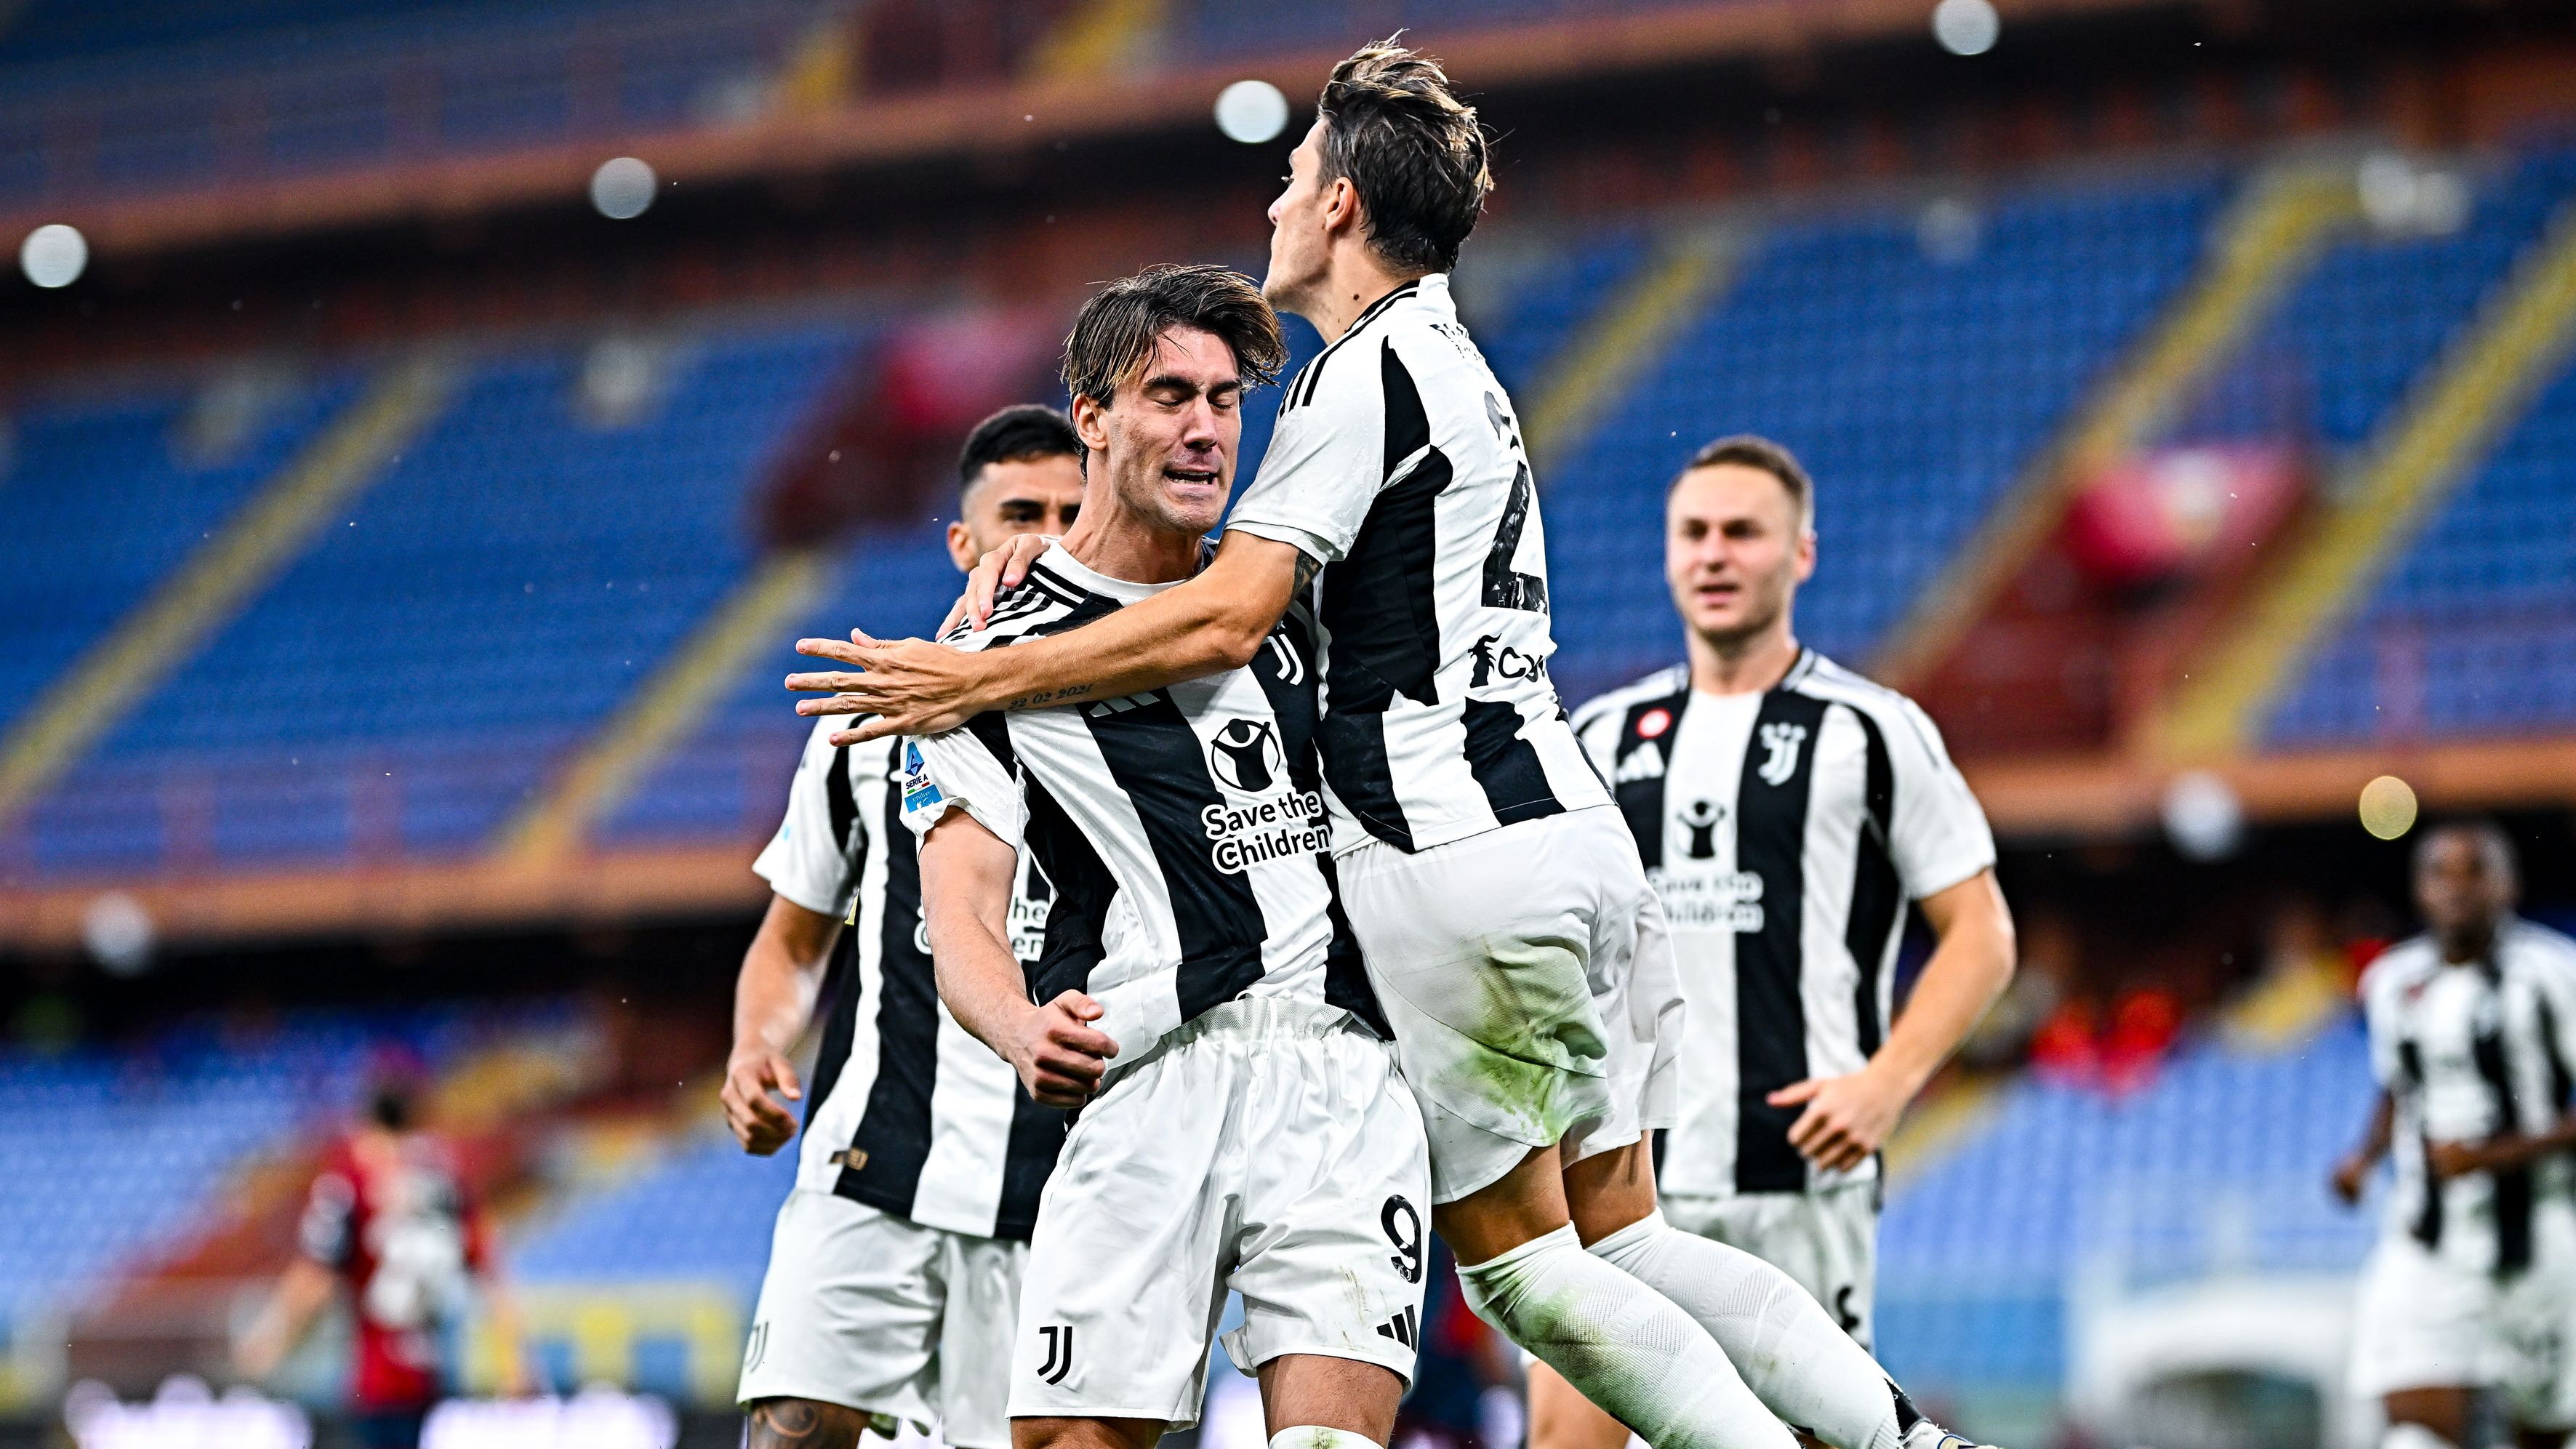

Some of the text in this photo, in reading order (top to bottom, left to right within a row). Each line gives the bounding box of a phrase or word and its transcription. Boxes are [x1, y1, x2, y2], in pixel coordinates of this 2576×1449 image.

[1008, 698, 1027, 710] 22
[1033, 692, 1051, 704] 02
[906, 773, 928, 790] SERIE A
[1206, 792, 1320, 835] Save the
[1216, 827, 1330, 870] Children
[1381, 1194, 1422, 1285] 9
